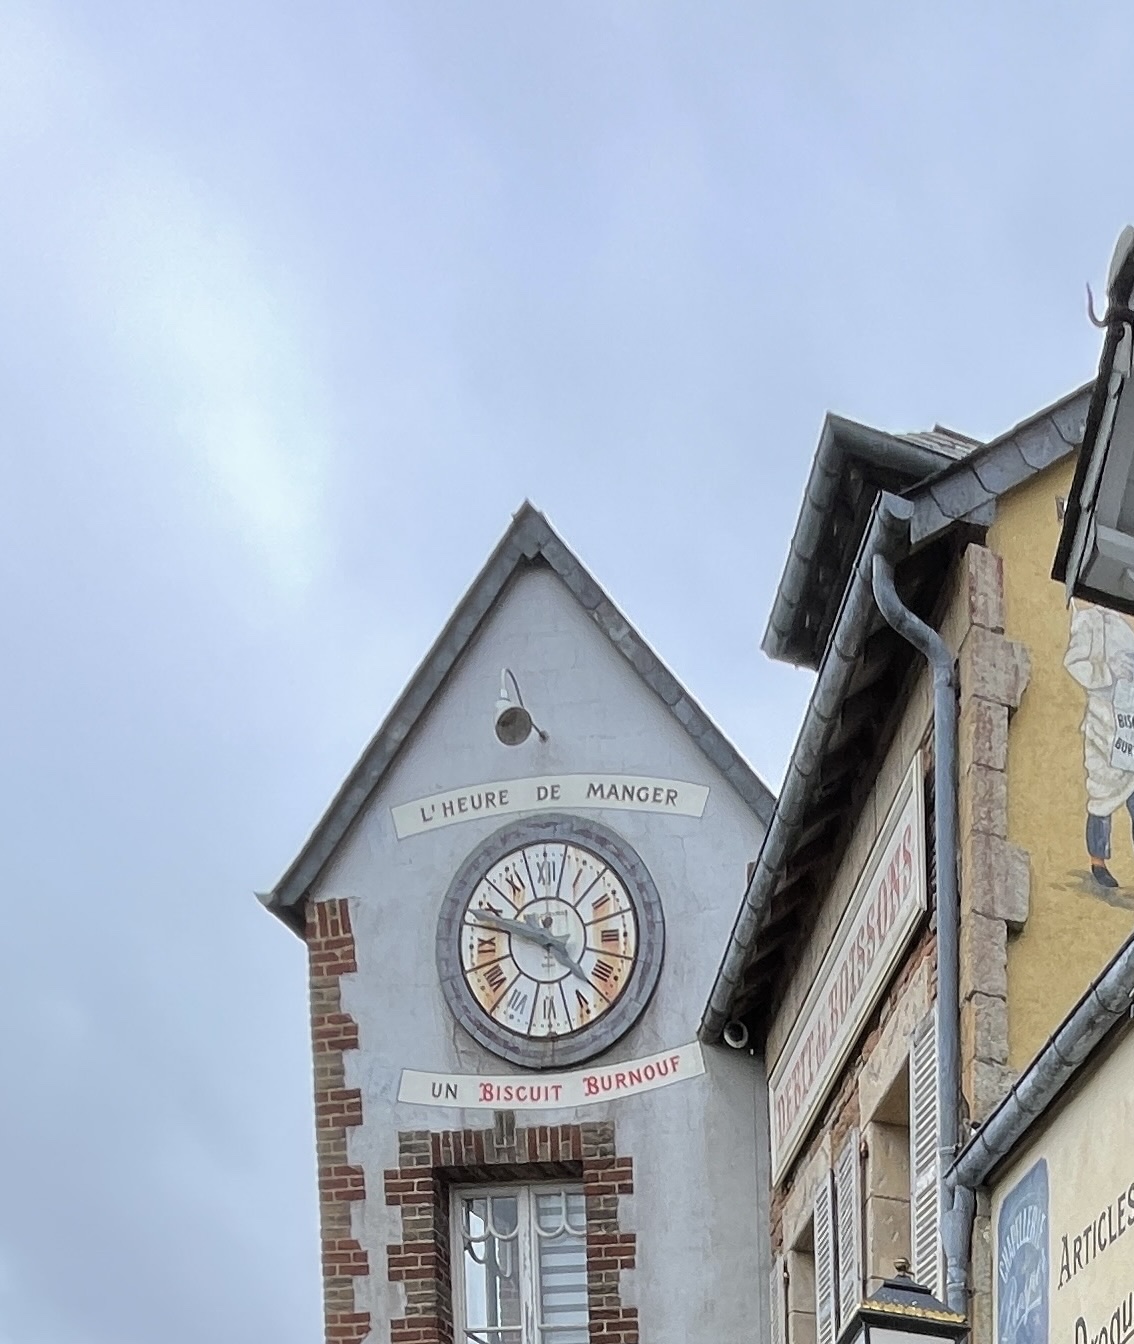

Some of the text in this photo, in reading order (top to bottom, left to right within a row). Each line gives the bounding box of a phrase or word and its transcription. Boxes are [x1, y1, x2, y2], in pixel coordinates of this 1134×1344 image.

[420, 782, 679, 822] L'HEURE DE MANGER
[828, 823, 912, 1038] BOISSONS
[431, 1055, 681, 1103] UN BISCUIT BURNOUF
